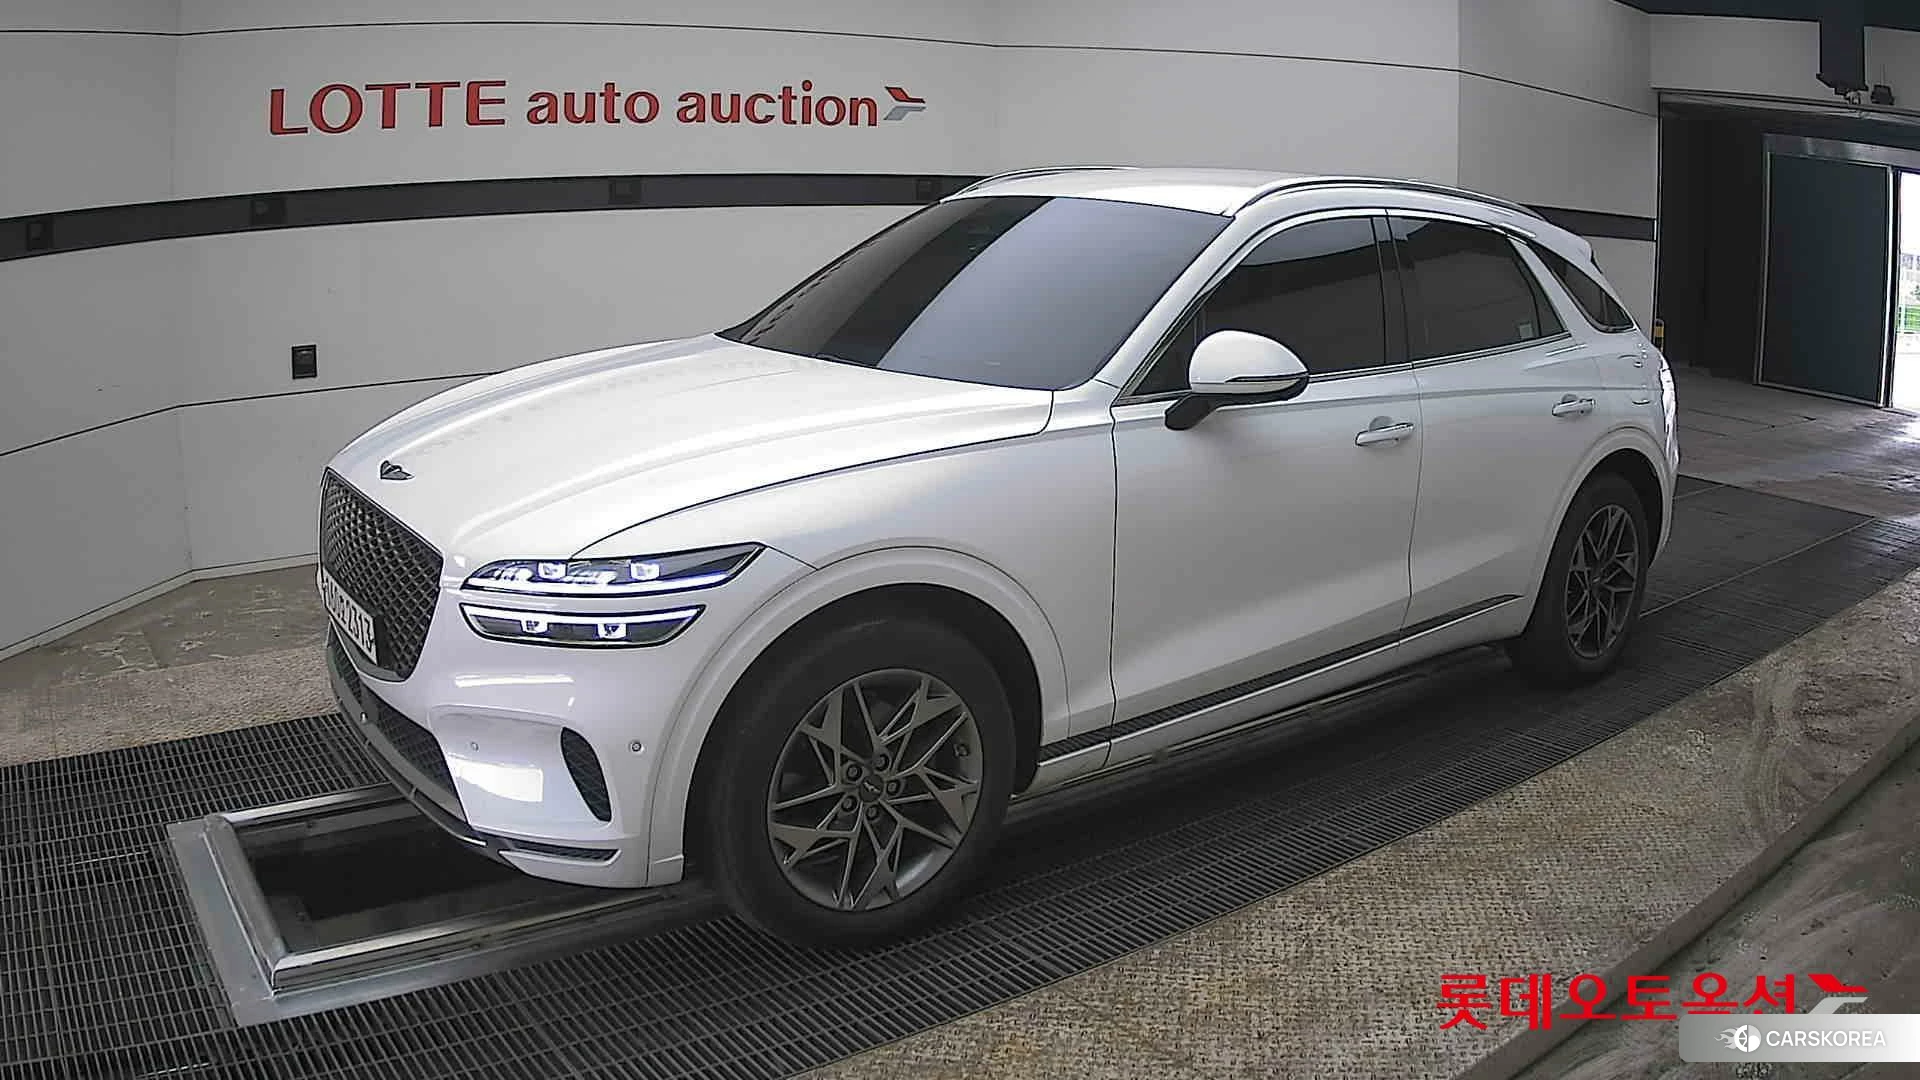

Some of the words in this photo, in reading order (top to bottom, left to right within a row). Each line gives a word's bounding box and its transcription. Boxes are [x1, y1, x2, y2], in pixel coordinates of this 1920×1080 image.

[270, 80, 506, 135] LOTTE
[526, 82, 660, 124] auto
[676, 80, 878, 126] auction
